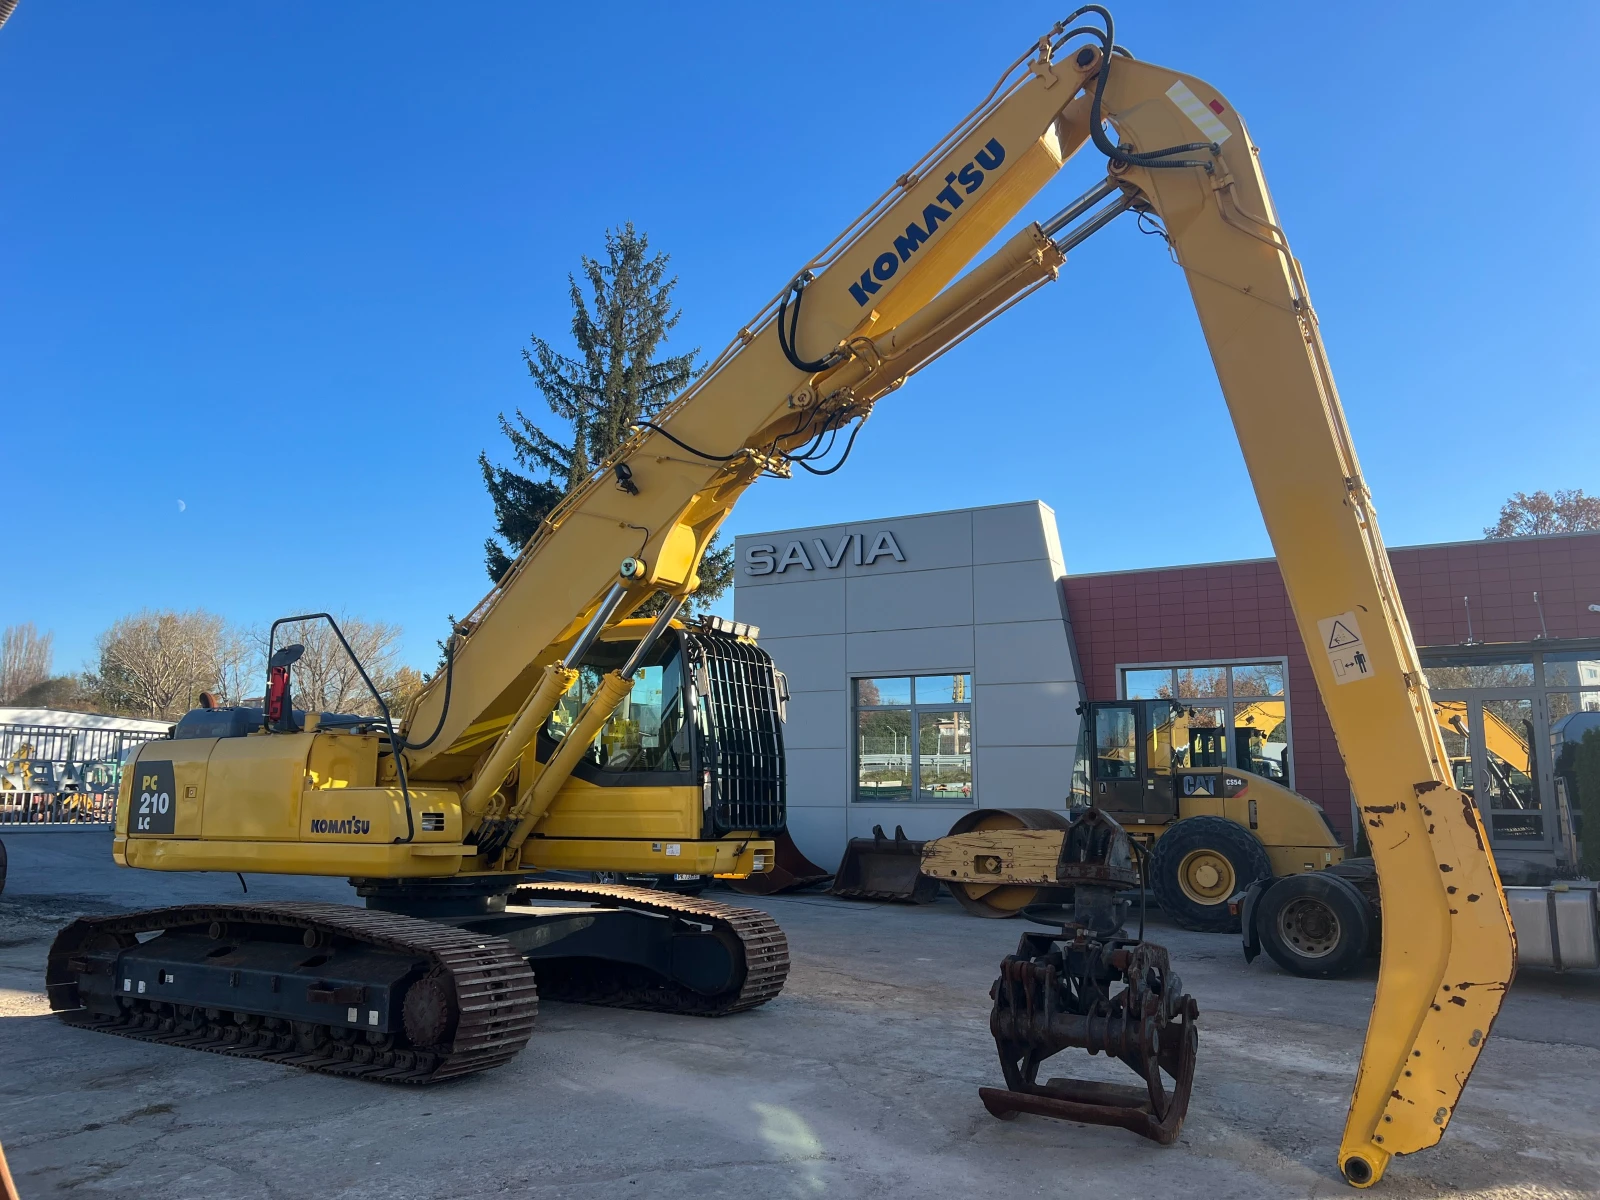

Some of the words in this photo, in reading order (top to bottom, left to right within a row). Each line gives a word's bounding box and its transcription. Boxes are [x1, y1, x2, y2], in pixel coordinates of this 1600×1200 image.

[848, 137, 1005, 307] KOMATSU
[744, 530, 906, 576] SAVIA
[142, 775, 158, 791] PC
[1183, 775, 1216, 795] CAT
[138, 792, 169, 814] 210
[137, 817, 150, 831] LC
[310, 815, 370, 835] KOMATSU
